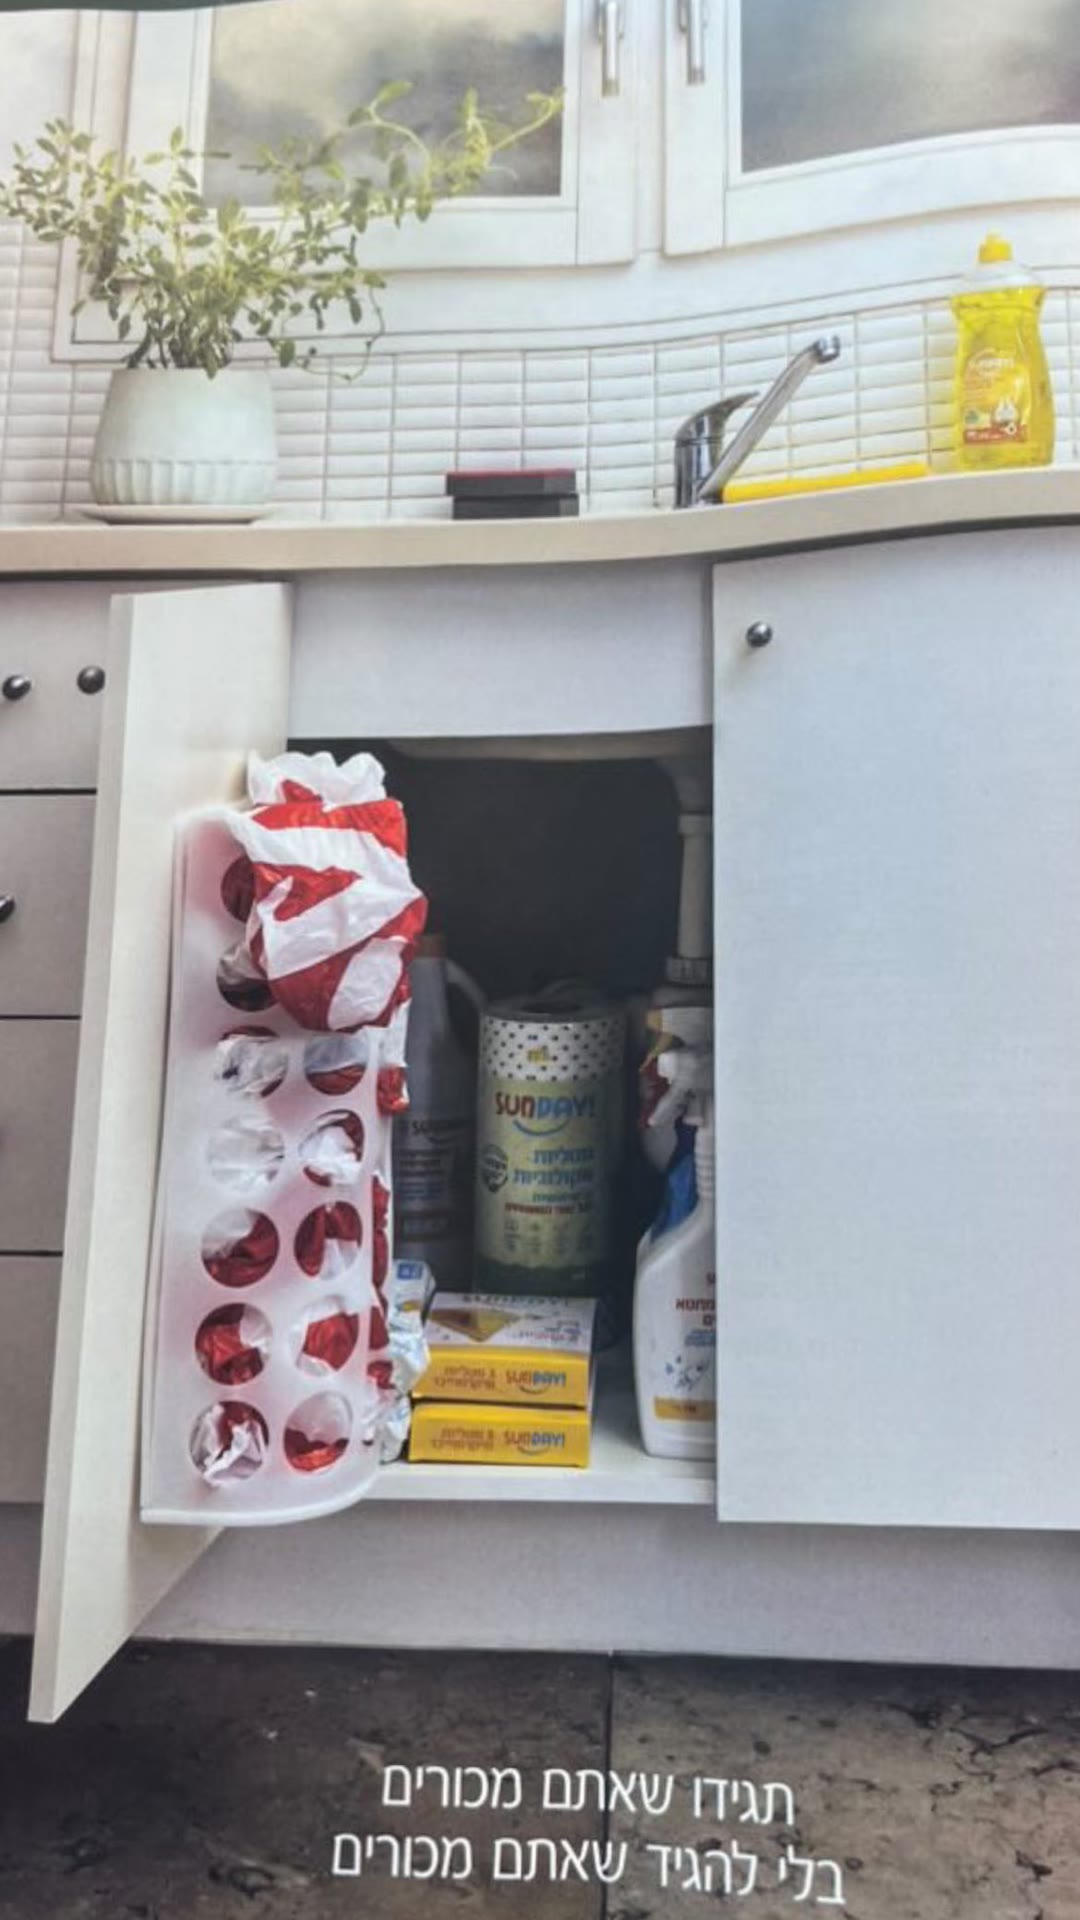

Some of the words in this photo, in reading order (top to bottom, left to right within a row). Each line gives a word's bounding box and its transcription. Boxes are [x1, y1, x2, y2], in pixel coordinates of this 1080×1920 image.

[382, 1765, 522, 1809] מכורים
[542, 1768, 674, 1815] שאתם
[694, 1777, 794, 1826] תגידו
[333, 1834, 472, 1879] מכורים
[493, 1838, 628, 1883] שאתם
[646, 1839, 758, 1896] להגיד
[779, 1845, 846, 1905] בלי
